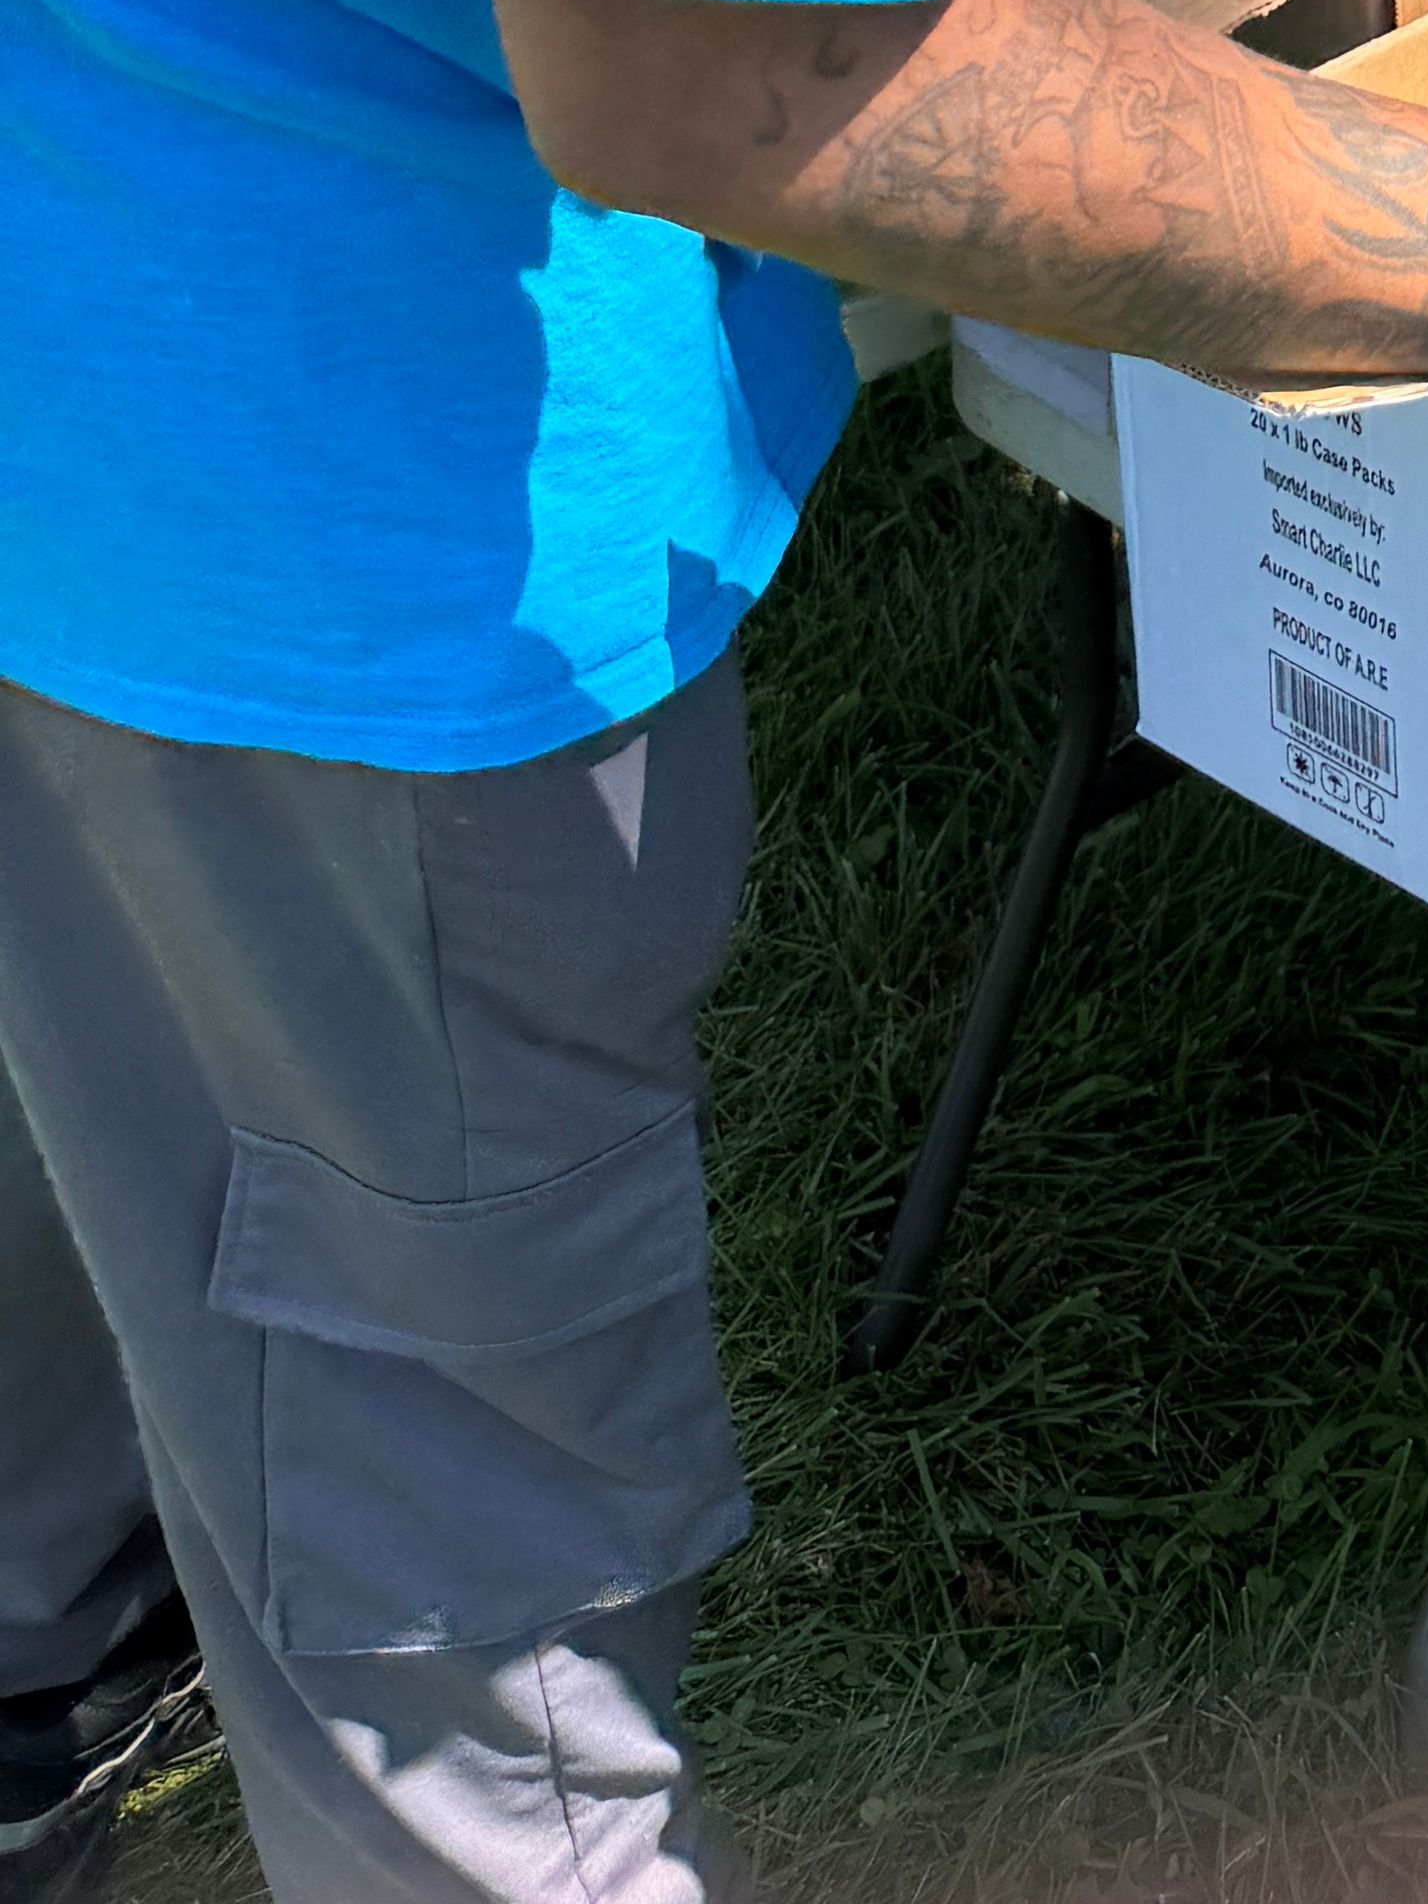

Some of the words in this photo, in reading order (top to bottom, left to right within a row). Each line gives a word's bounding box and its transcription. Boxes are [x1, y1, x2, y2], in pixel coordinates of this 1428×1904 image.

[1251, 407, 1267, 432] 20
[1312, 438, 1348, 472] Case
[1352, 456, 1396, 495] Packs
[1272, 508, 1307, 550] Smart
[1310, 528, 1353, 573] Charlie
[1355, 552, 1380, 588] LLC
[1259, 553, 1319, 602] Aurora,
[1349, 600, 1397, 640] 80016
[1273, 606, 1332, 659] PRODUCT
[1335, 642, 1353, 669] OF
